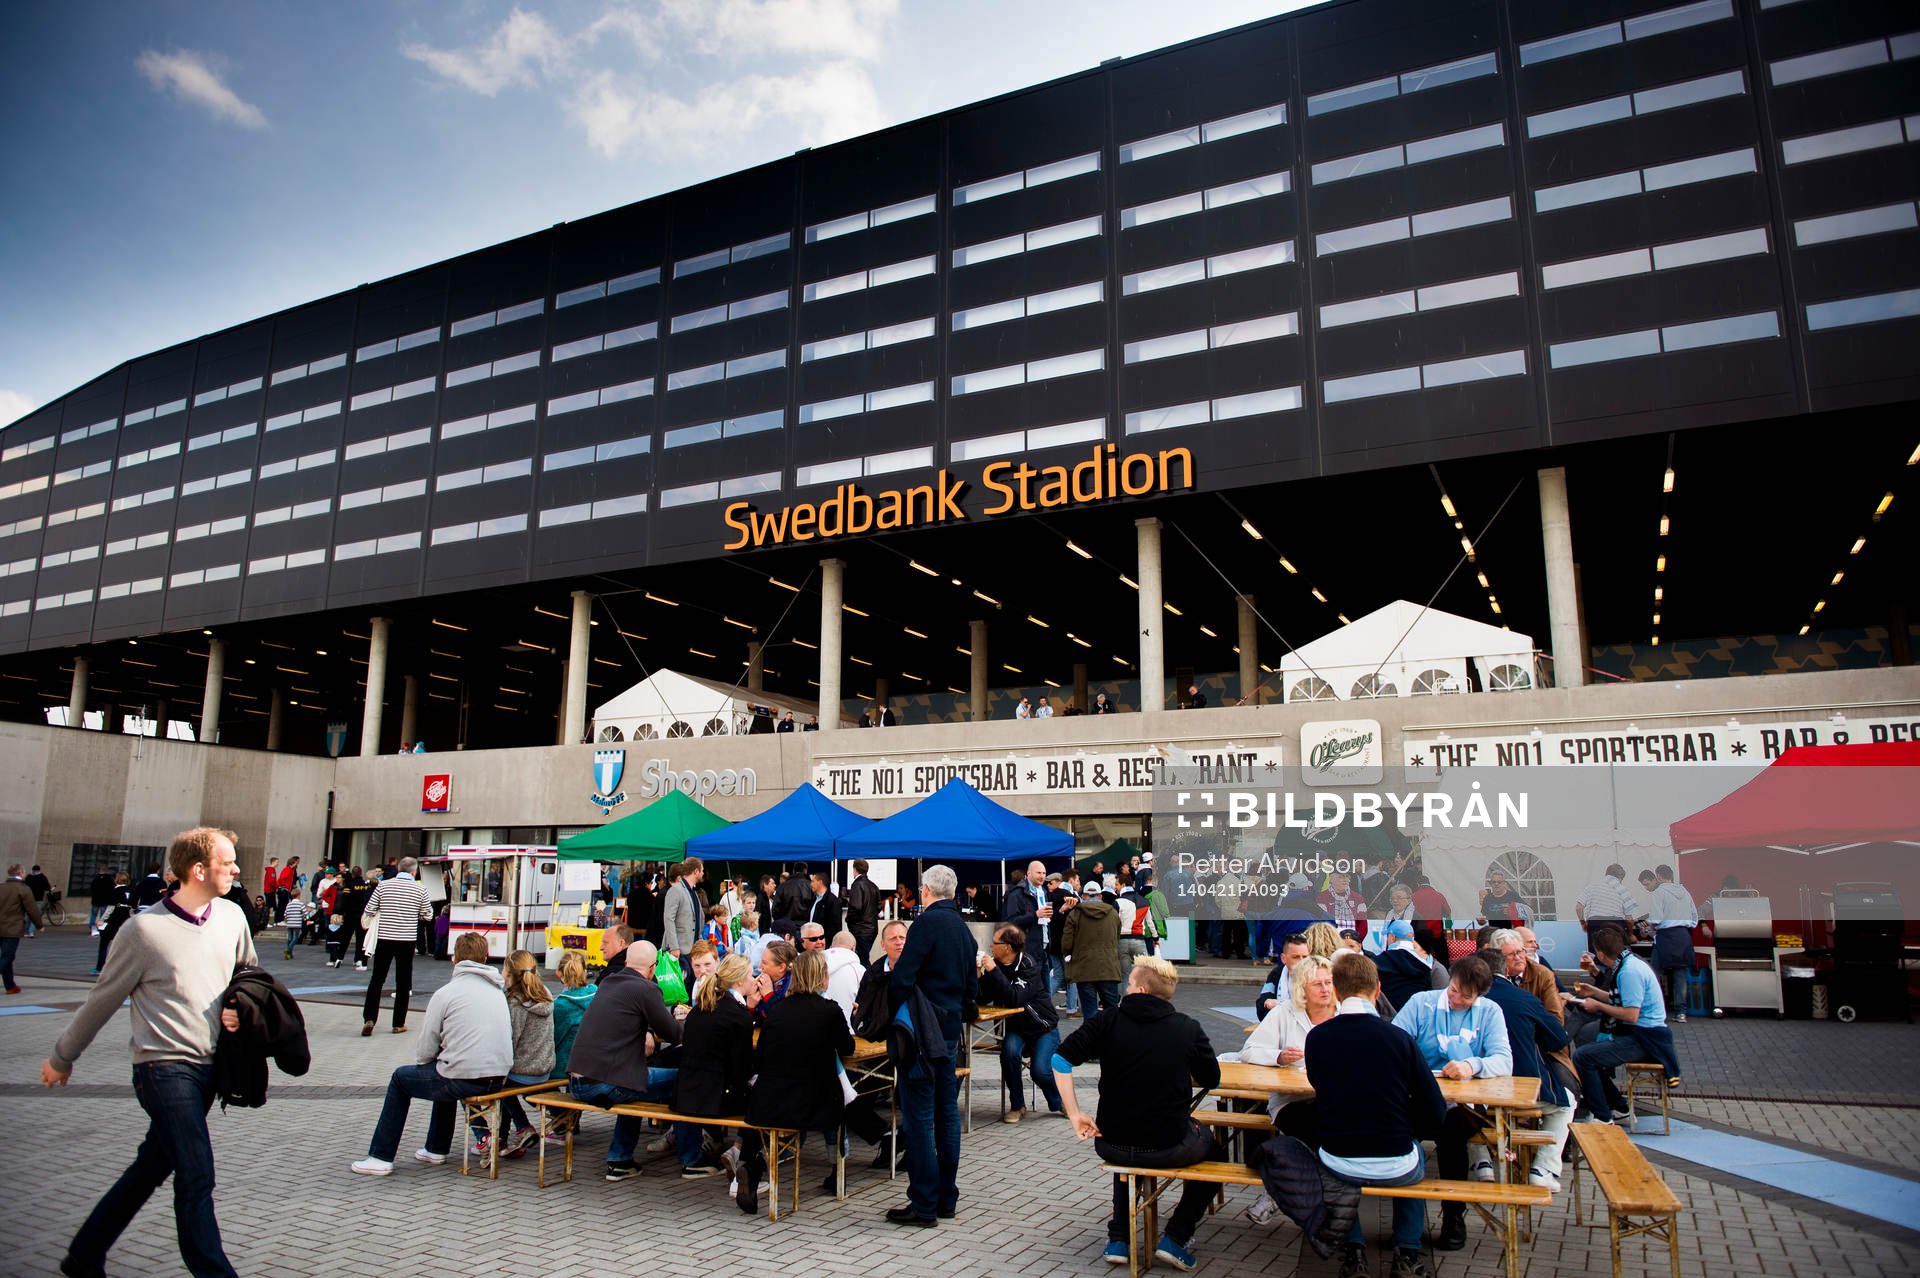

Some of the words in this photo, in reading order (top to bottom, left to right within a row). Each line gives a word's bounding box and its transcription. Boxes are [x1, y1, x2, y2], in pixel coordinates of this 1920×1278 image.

[724, 469, 965, 551] Swedbank
[982, 443, 1193, 515] Stadion
[829, 769, 862, 796] THE
[872, 767, 904, 795] NO1
[914, 763, 1018, 793] SPORTSBAR
[1046, 759, 1086, 789] BAR
[1092, 763, 1111, 788] &
[1118, 752, 1258, 787] RESTRANT
[1429, 743, 1478, 776] THE
[1560, 732, 1717, 764] SPORTSBAR
[640, 759, 757, 807] Shopen
